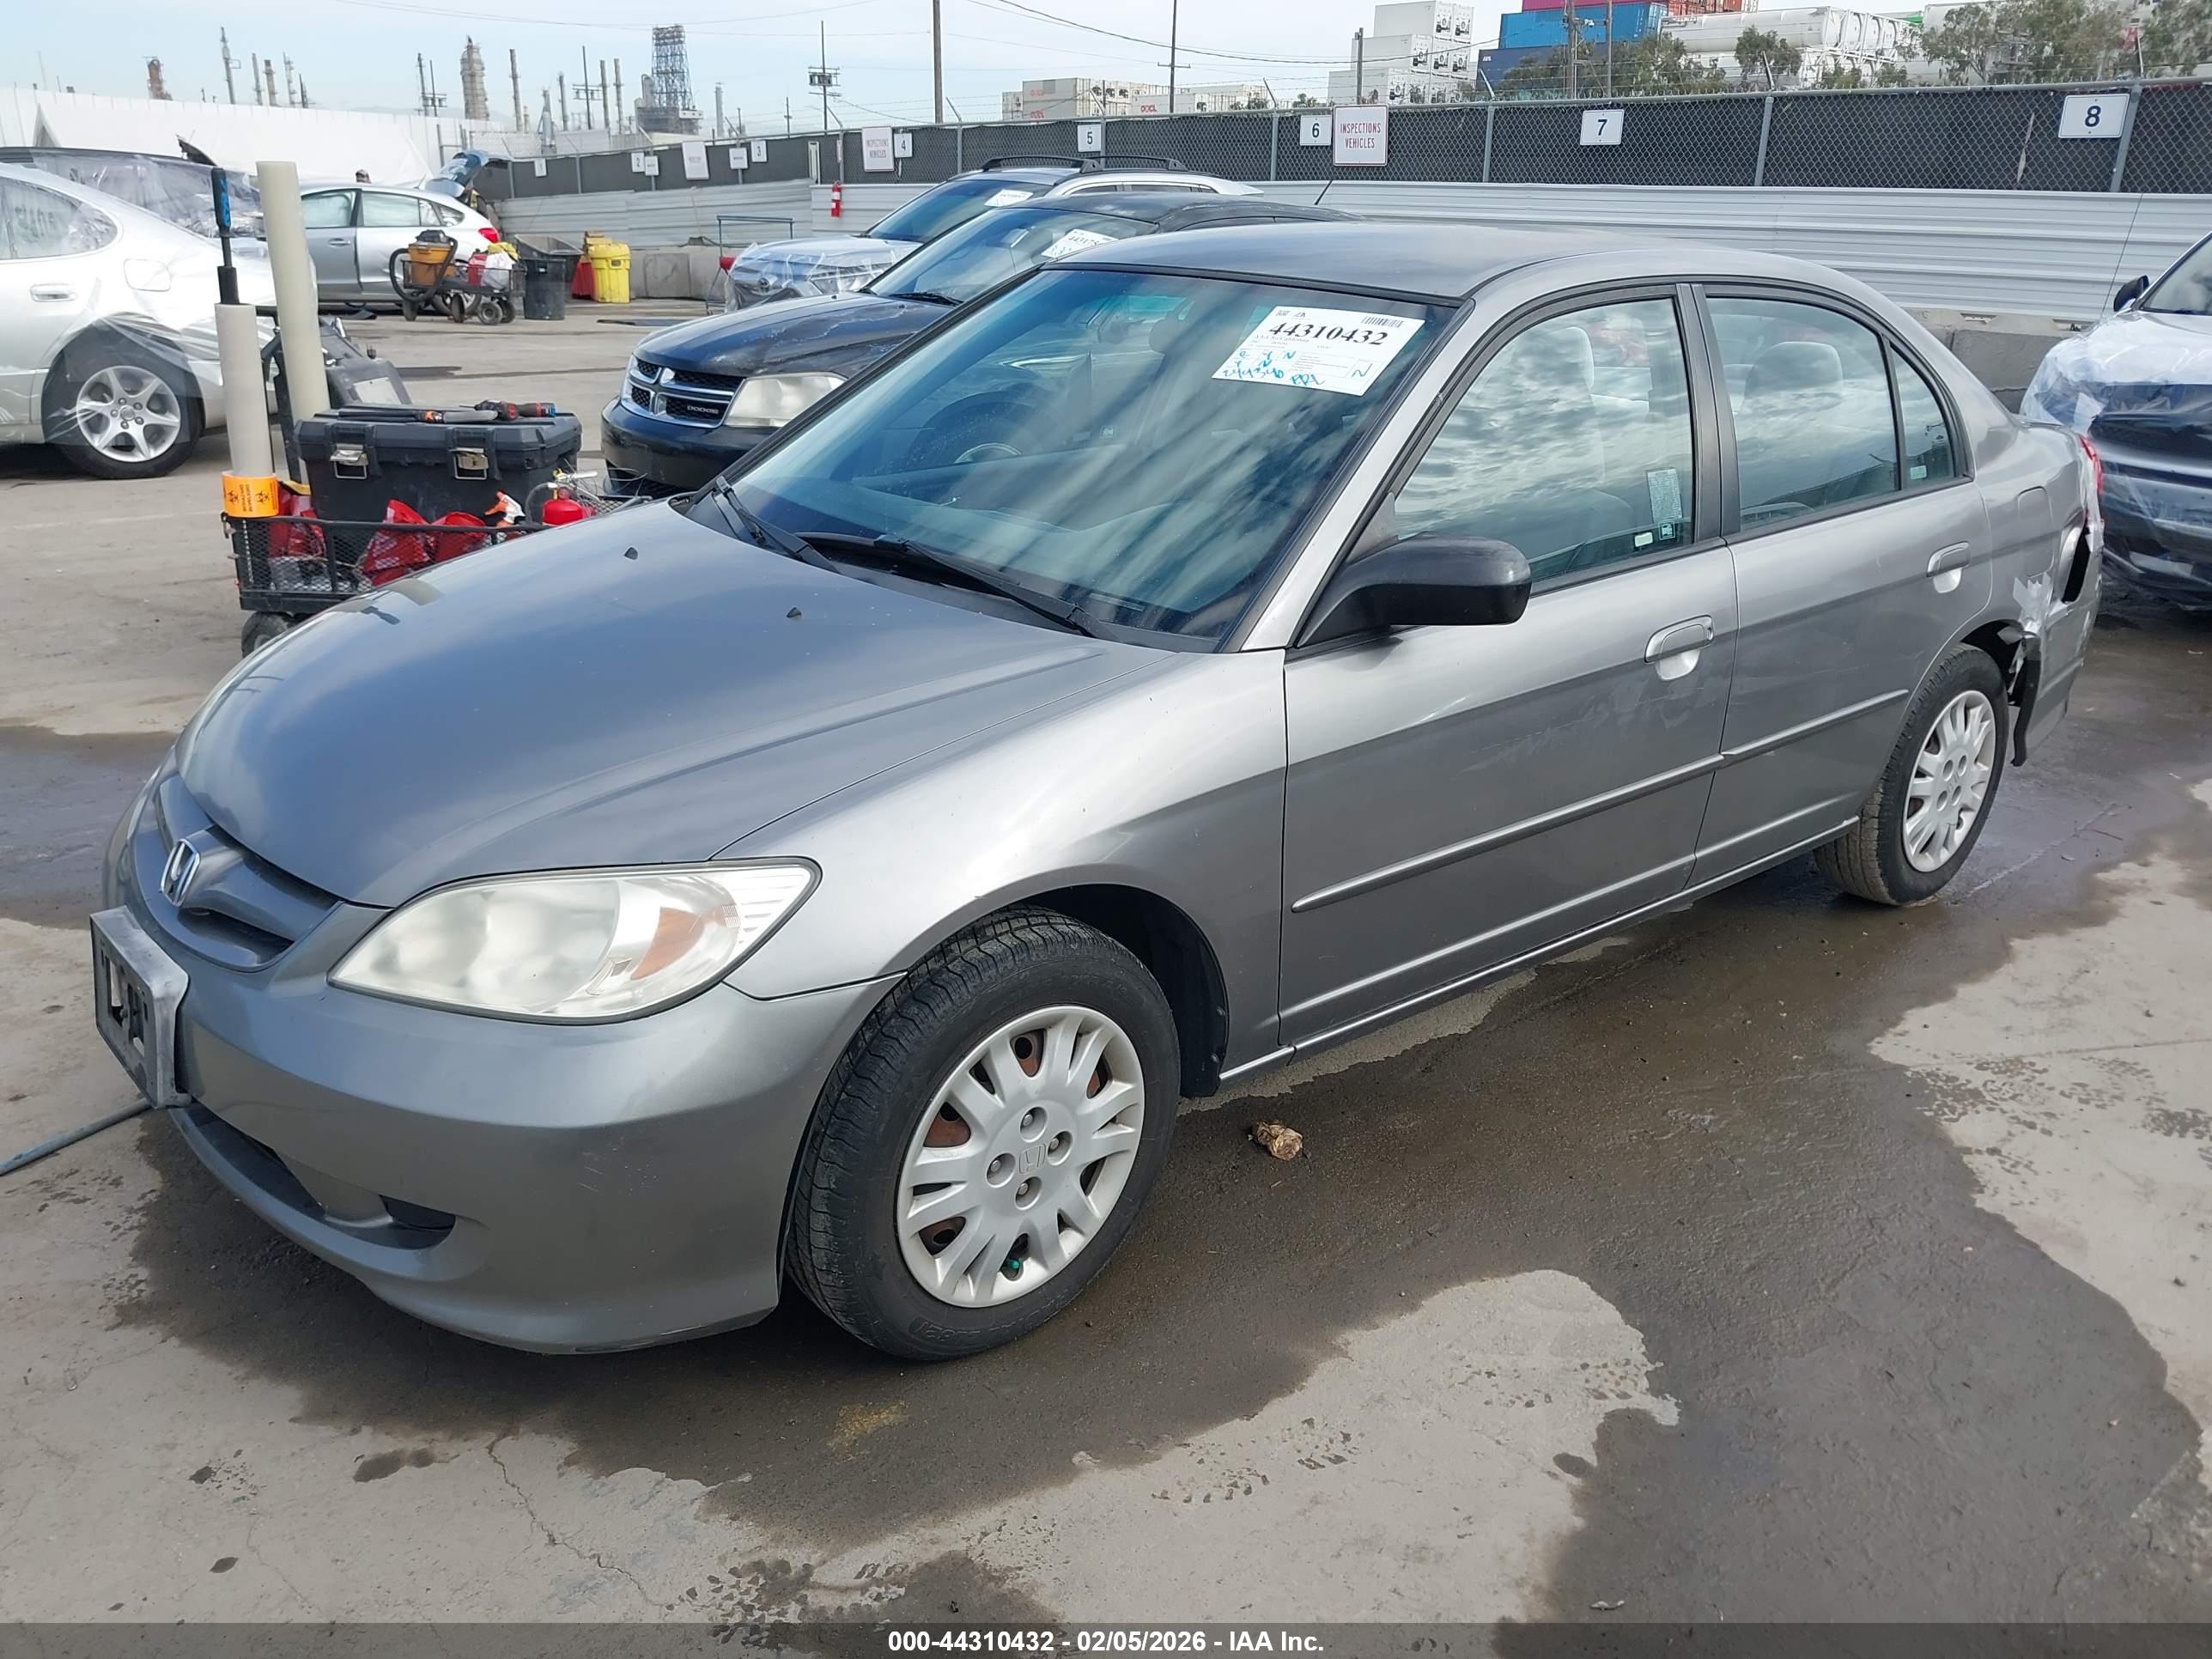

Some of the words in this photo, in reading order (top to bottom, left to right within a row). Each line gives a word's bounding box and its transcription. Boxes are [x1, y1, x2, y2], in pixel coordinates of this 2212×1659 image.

[2085, 105, 2101, 127] 8
[1312, 123, 1320, 137] 6
[1340, 123, 1382, 133] INSPECTIONS
[1598, 119, 1607, 136] 7
[1086, 131, 1093, 145] 5
[1345, 137, 1375, 149] VEHICLES
[757, 146, 762, 156] 3
[901, 140, 906, 151] 4
[636, 158, 641, 167] 2
[1269, 322, 1389, 345] 44310432
[687, 405, 719, 414] DODGE
